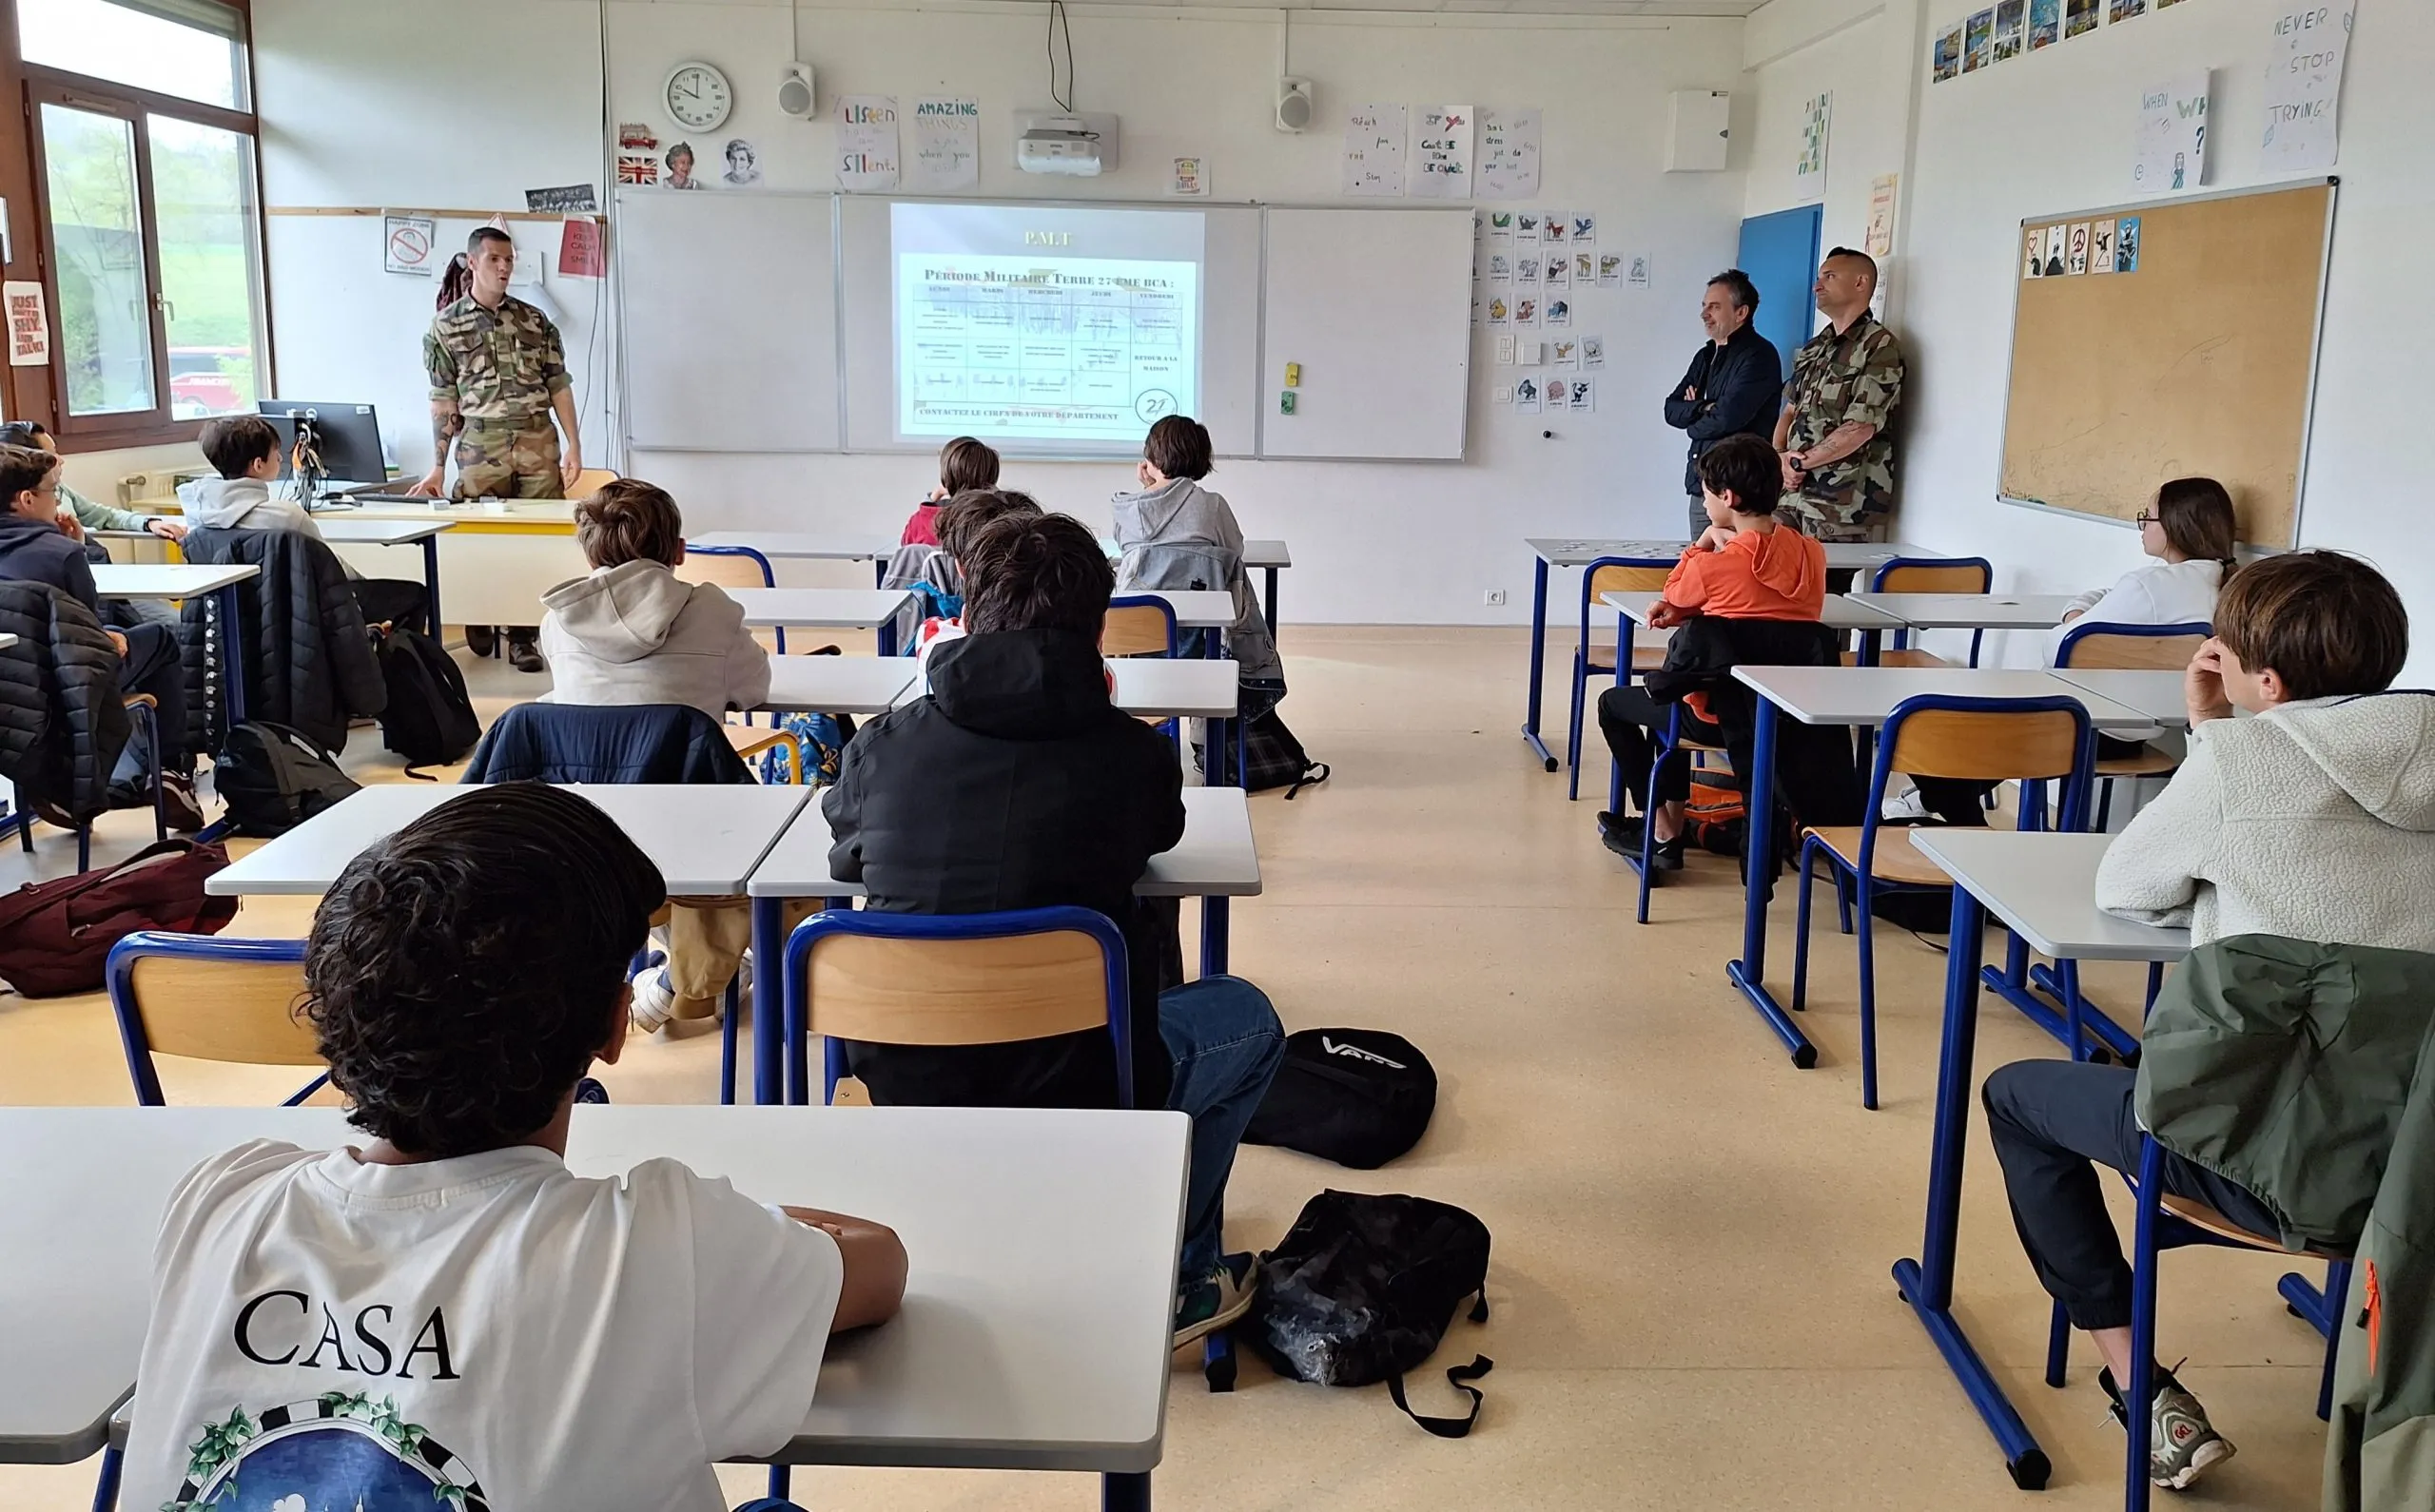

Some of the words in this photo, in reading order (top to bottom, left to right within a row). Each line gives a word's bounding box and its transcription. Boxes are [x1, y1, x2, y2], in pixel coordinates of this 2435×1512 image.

[2274, 8, 2328, 36] NEVER
[2289, 50, 2334, 73] STOP
[917, 98, 978, 116] AMAZING
[2143, 92, 2169, 110] WHEN
[2269, 100, 2324, 125] TRYING
[984, 270, 1049, 284] MILITAIRE
[1052, 273, 1094, 285] TERRE
[919, 408, 969, 417] CONTACTEZ
[1322, 1036, 1408, 1069] VANS
[233, 1289, 461, 1381] CASA
